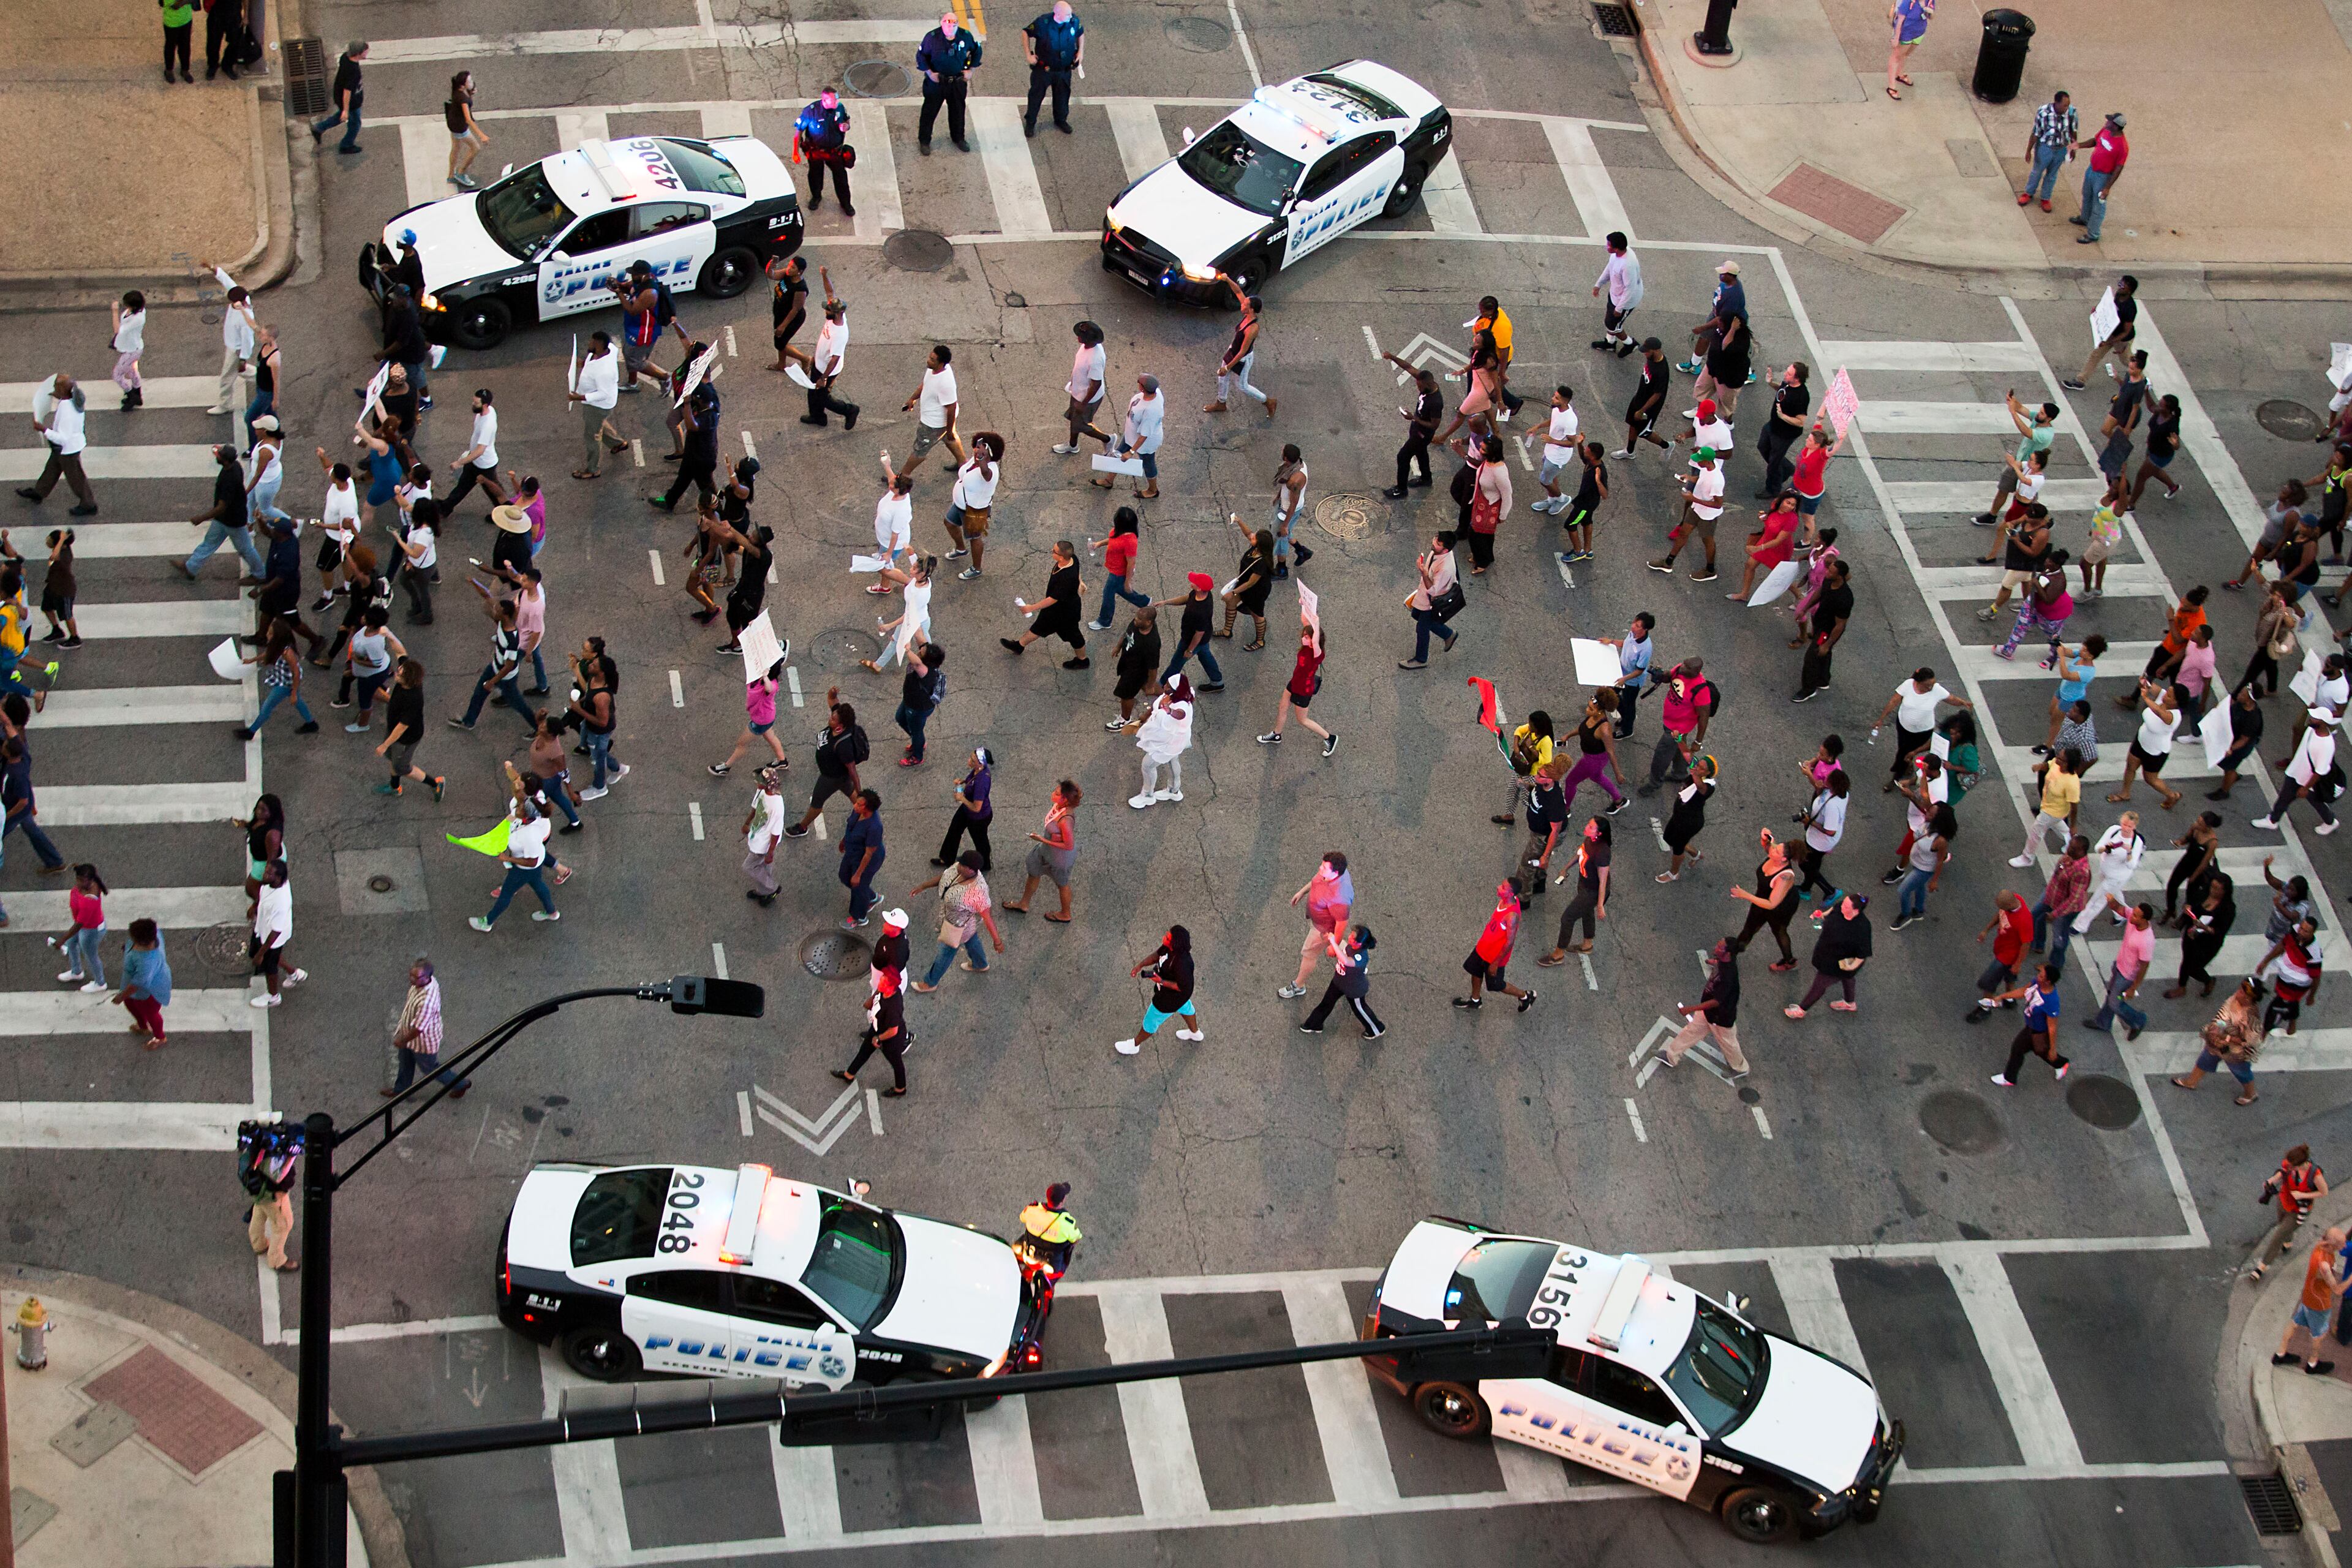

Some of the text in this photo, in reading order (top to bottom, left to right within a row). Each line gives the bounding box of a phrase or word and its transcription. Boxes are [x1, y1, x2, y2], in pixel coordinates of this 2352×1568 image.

[1292, 81, 1369, 123] 3123
[630, 140, 678, 189] 4206
[1303, 179, 1390, 243] POLICE
[1267, 227, 1287, 245] 3123
[502, 274, 537, 286] 4206
[554, 259, 612, 279] DALLAS
[658, 1172, 705, 1254] 2048
[1529, 1251, 1588, 1327] 3156
[644, 1333, 813, 1371] POLICE
[756, 1335, 833, 1352] DALLAS
[858, 1349, 903, 1363] 2048
[1499, 1400, 1659, 1467] POLICE
[1618, 1420, 1689, 1452] DALLAS
[1703, 1453, 1745, 1476] 3156
